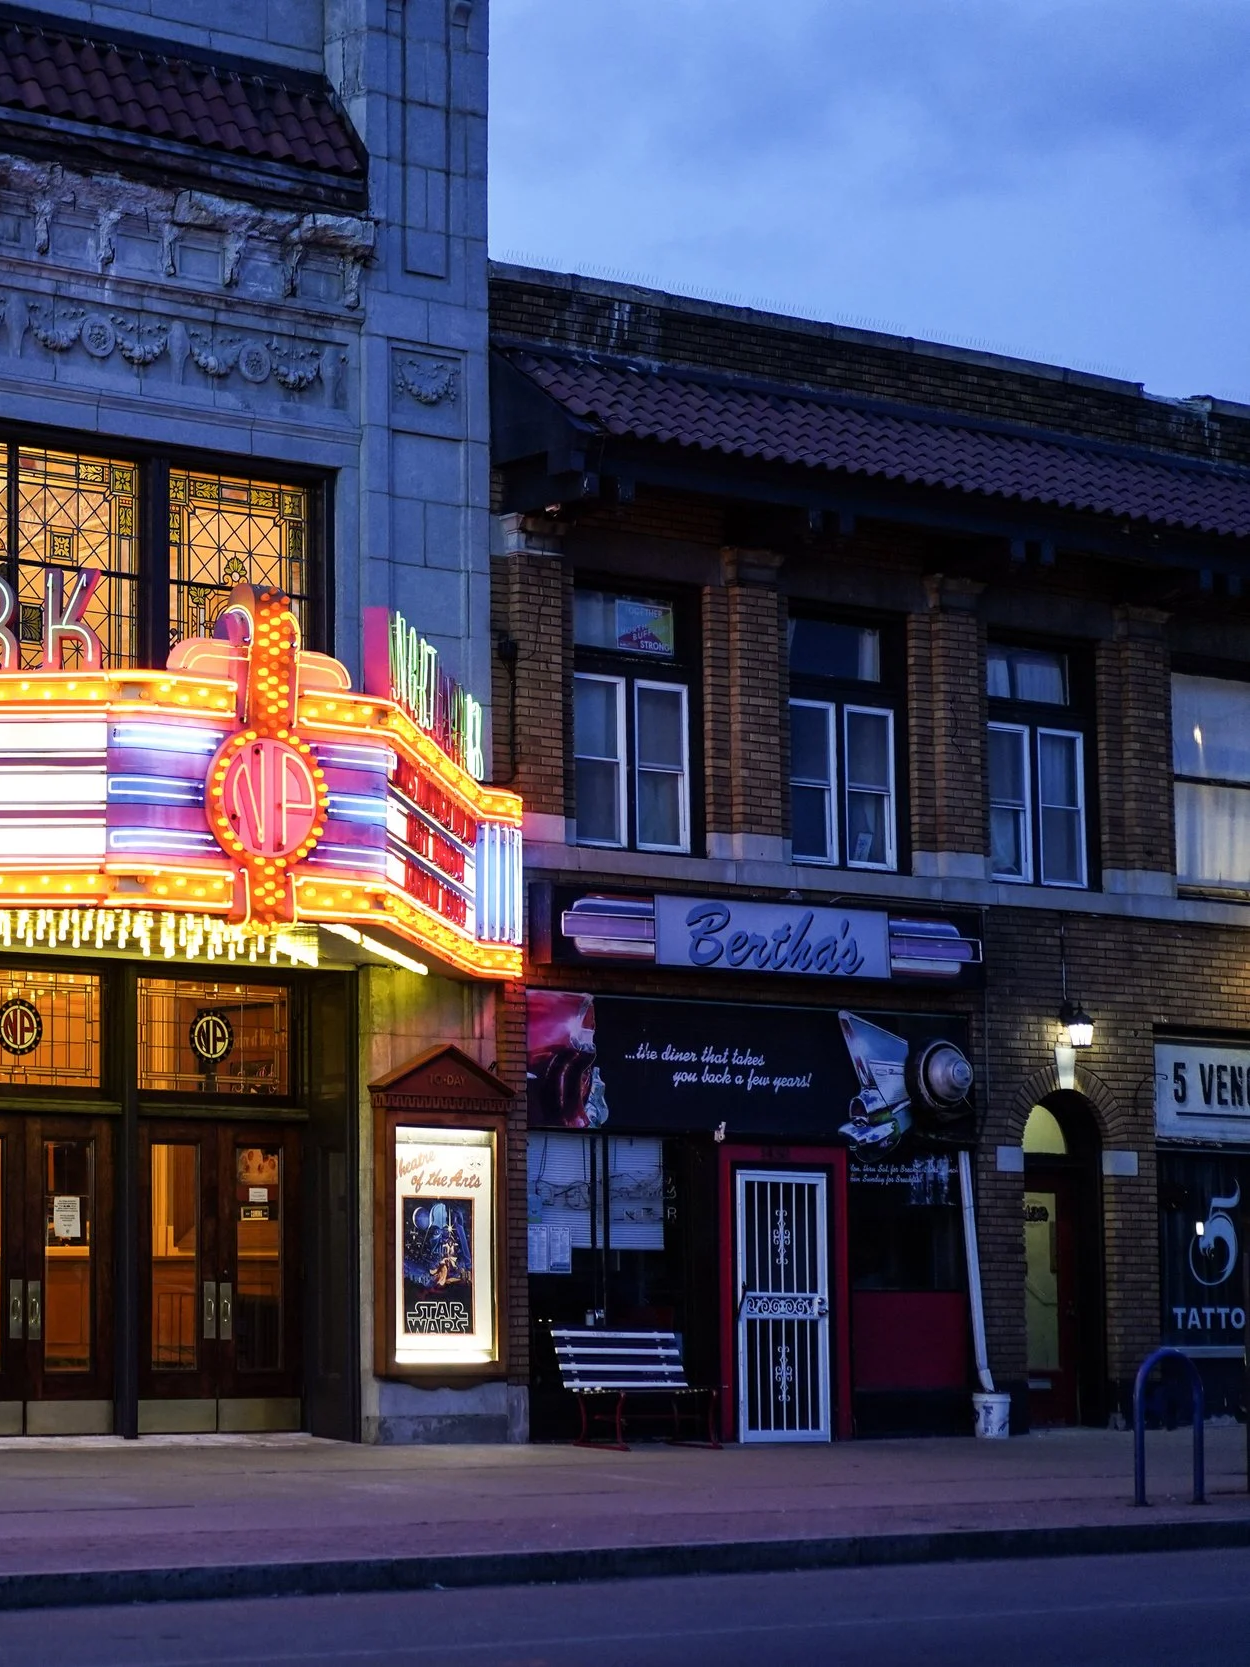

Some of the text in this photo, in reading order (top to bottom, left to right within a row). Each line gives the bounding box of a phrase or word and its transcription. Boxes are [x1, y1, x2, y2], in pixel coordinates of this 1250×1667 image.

[639, 640, 670, 652] STRONG
[685, 902, 865, 976] Bertha's
[661, 1044, 697, 1062] diner
[701, 1046, 729, 1064] that
[731, 1048, 765, 1066] takes
[672, 1065, 812, 1094] you back a few years!
[1173, 1062, 1187, 1105] 5
[397, 1150, 436, 1180] heatre
[411, 1168, 482, 1193] of the Arts
[406, 1301, 469, 1319] STAR
[406, 1319, 469, 1335] WARS
